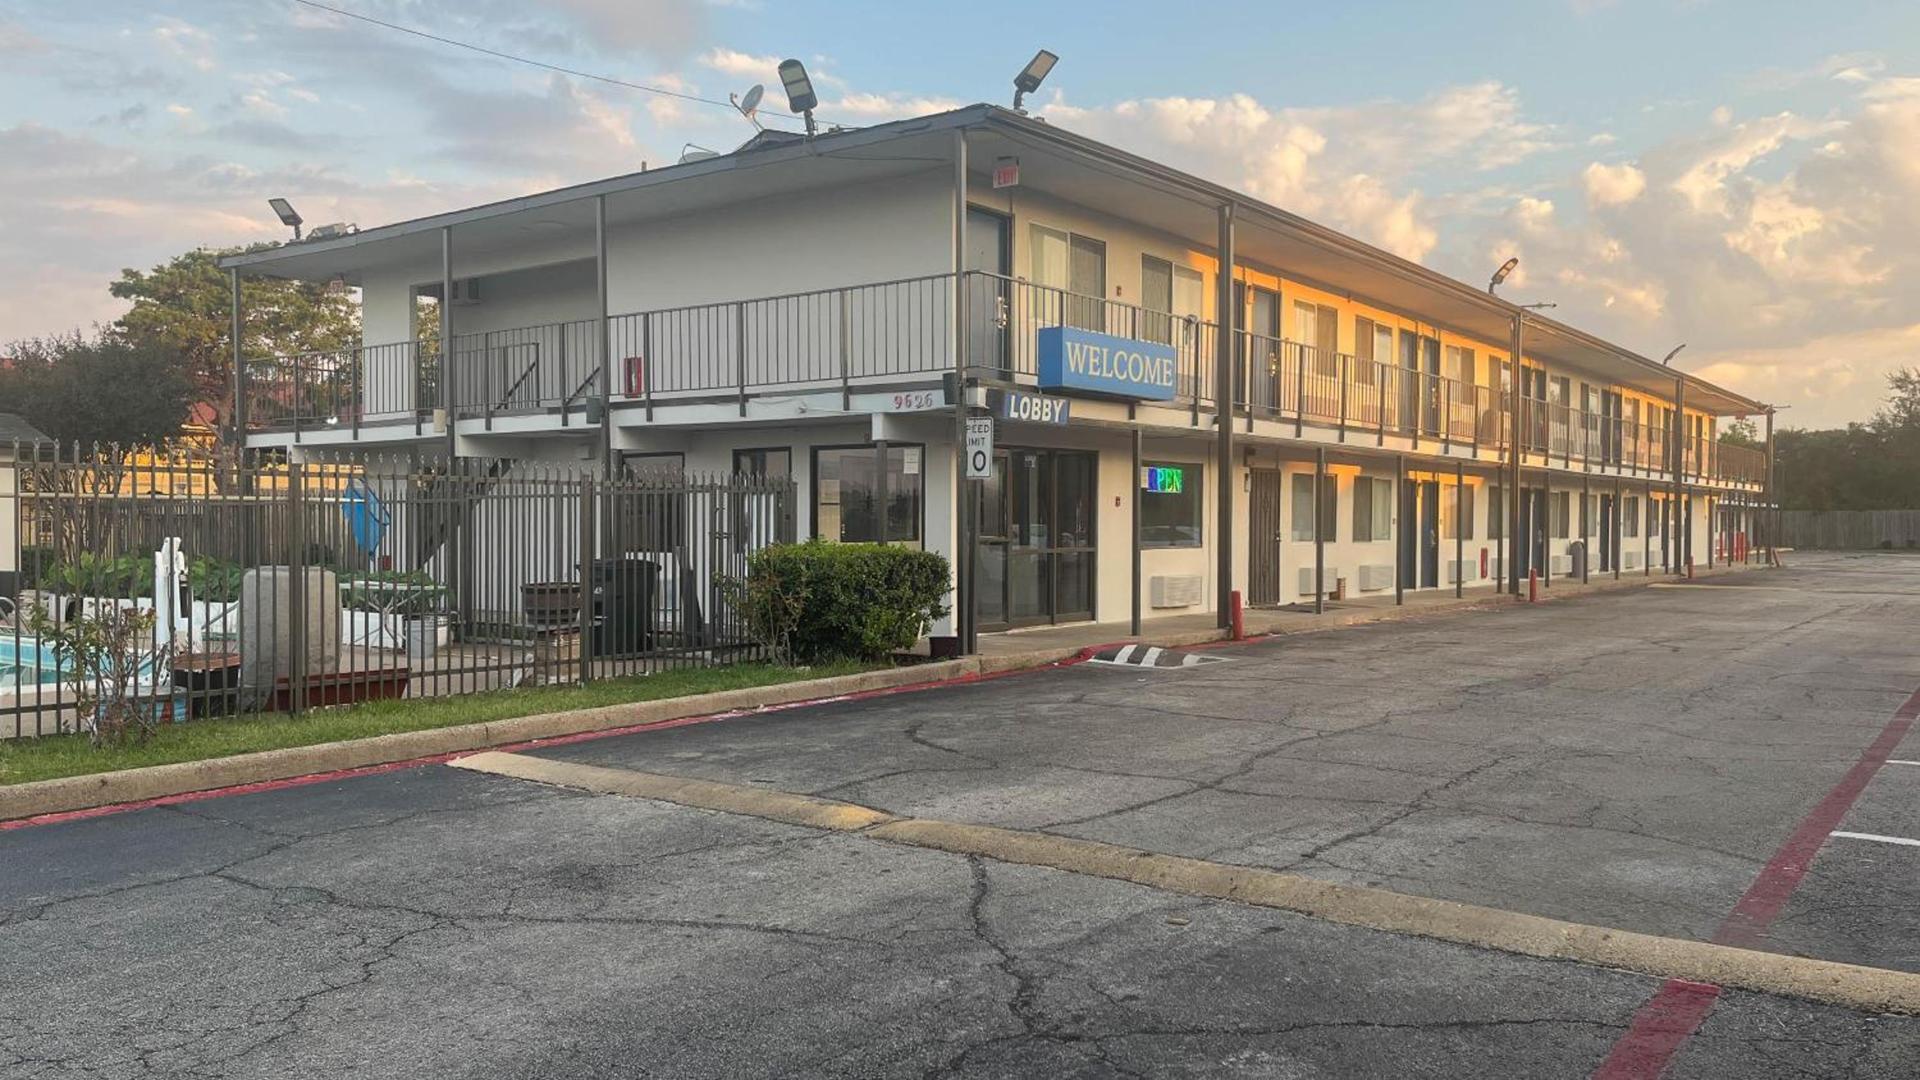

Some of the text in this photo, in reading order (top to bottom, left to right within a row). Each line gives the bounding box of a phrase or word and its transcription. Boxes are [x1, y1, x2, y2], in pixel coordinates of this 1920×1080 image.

[1065, 341, 1174, 387] WELCOME
[894, 393, 933, 410] 9626
[1009, 395, 1066, 423] LOBBY
[964, 424, 990, 433] PEED
[968, 437, 985, 446] IMIT
[972, 450, 986, 472] 0
[1148, 467, 1182, 492] OPEN
